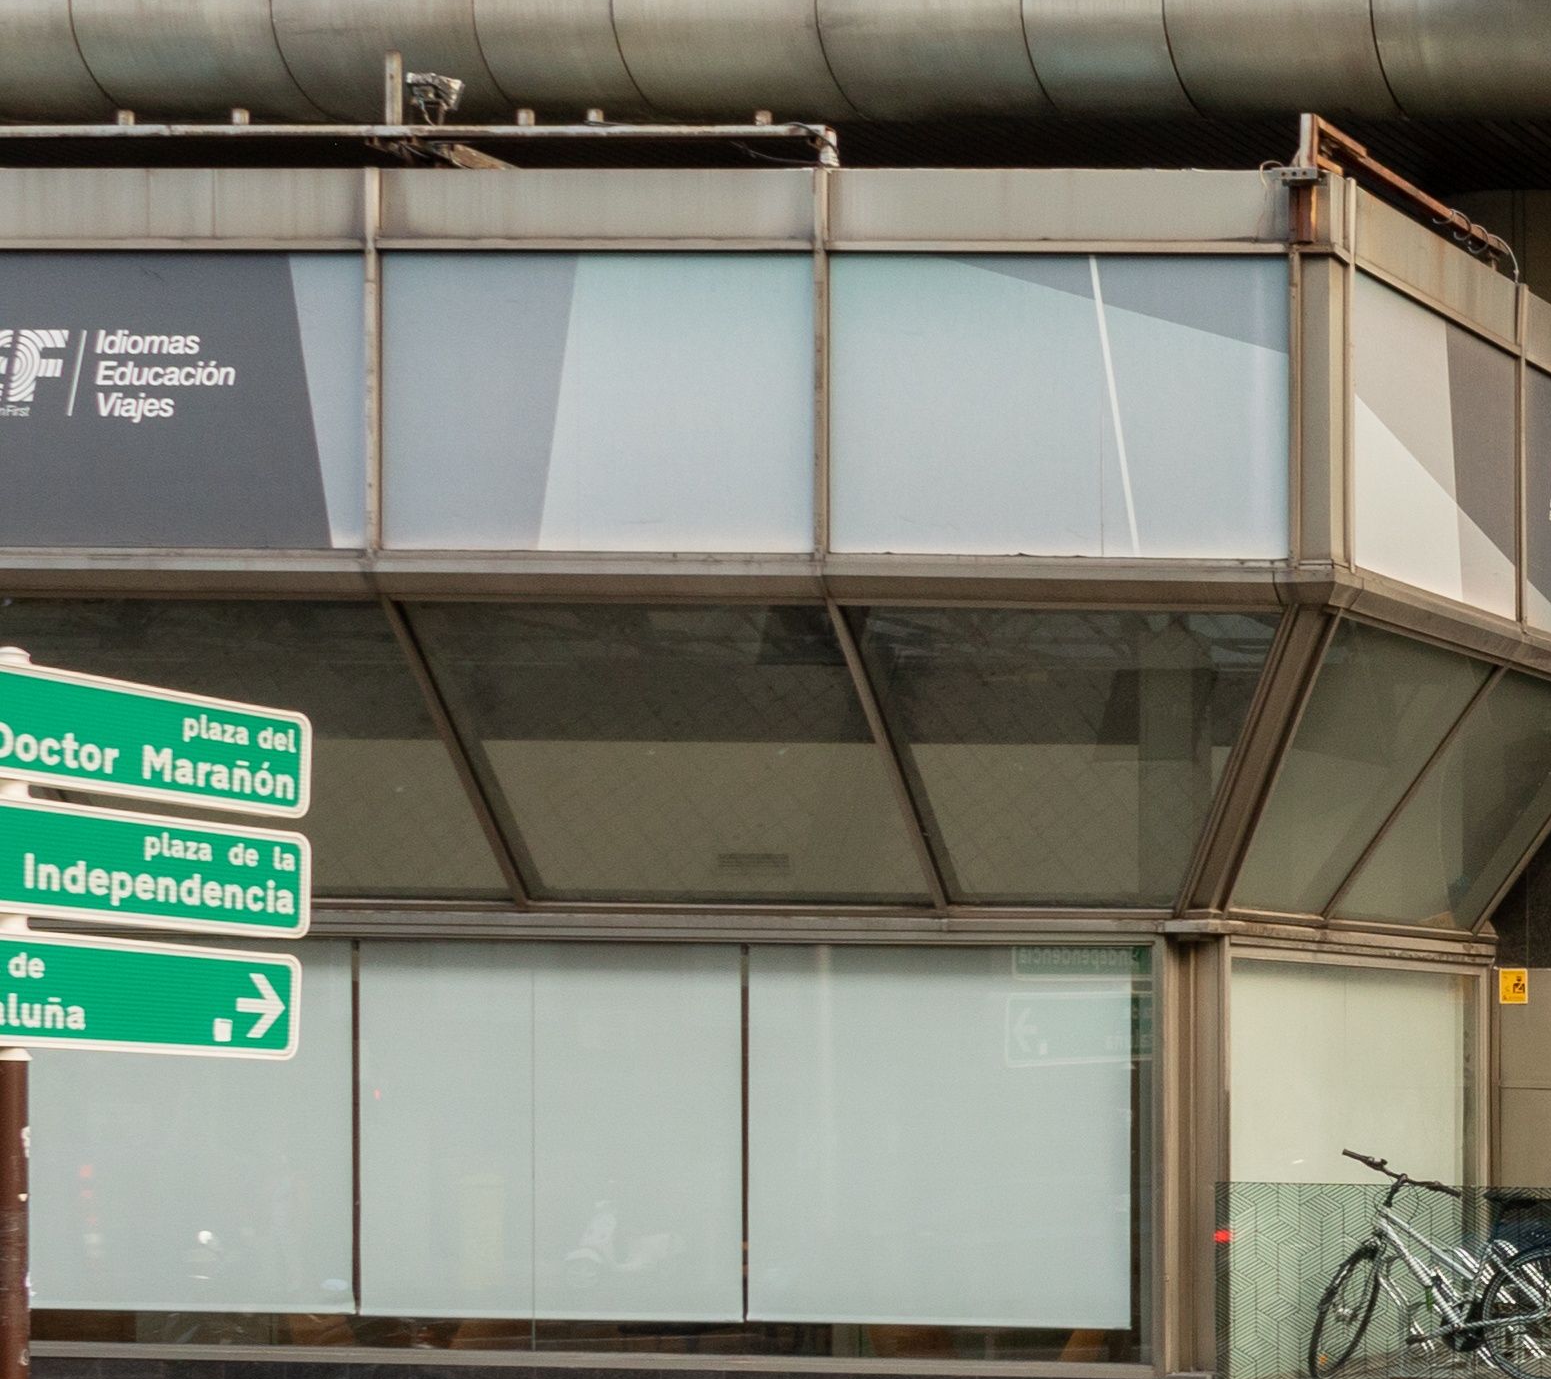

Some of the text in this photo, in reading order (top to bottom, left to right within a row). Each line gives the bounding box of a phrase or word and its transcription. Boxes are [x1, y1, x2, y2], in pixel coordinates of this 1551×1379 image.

[95, 329, 200, 354] Idiomas
[0, 329, 69, 402] F
[95, 360, 236, 386] Educación
[97, 392, 175, 423] Viajes
[182, 714, 296, 754] plaza del
[142, 743, 295, 801] Marañón
[144, 832, 295, 872] plaza de la
[23, 852, 295, 916] Independencia
[8, 952, 46, 979] de
[0, 993, 86, 1031] luña
